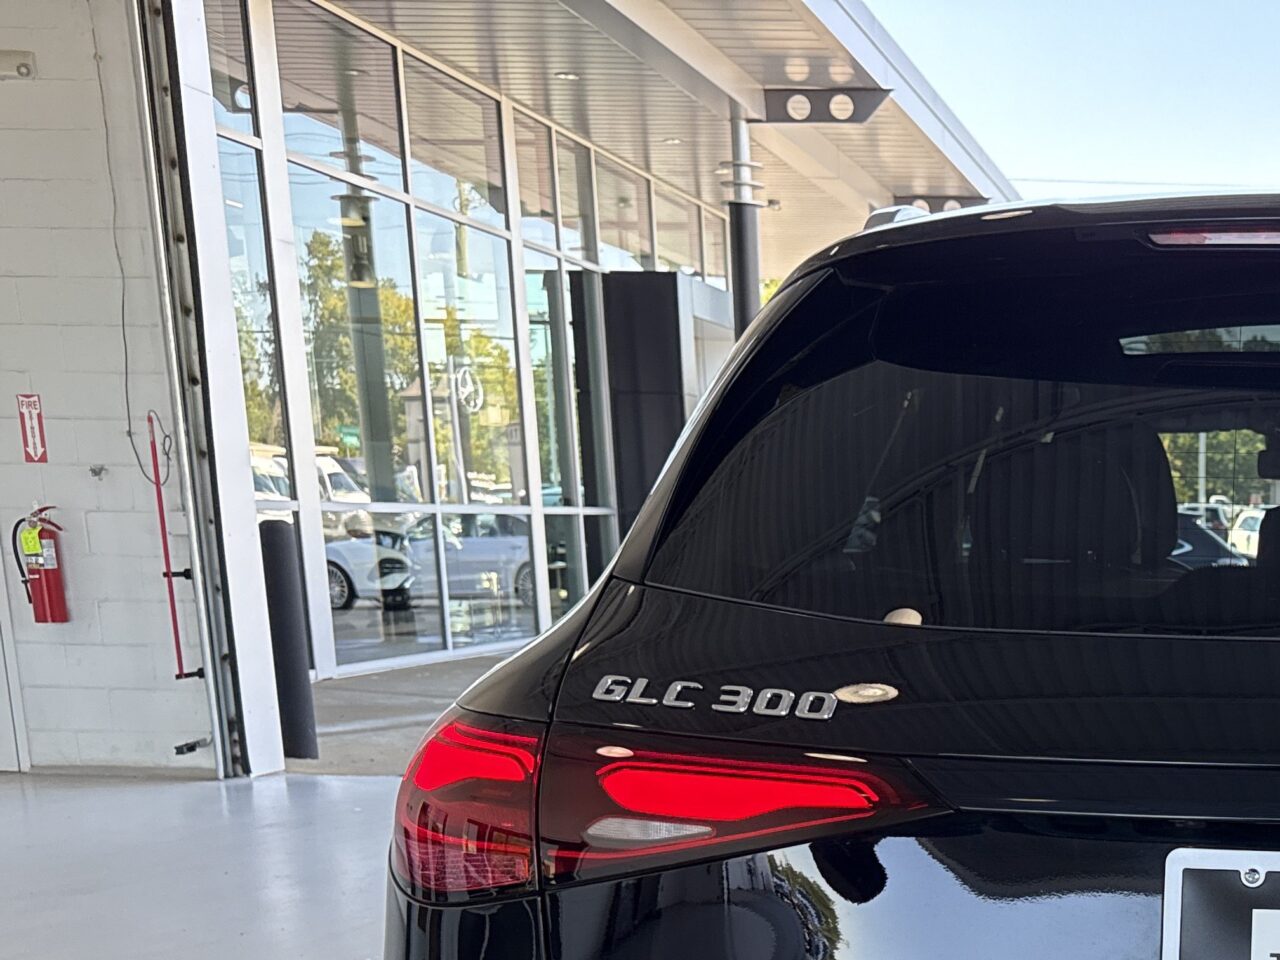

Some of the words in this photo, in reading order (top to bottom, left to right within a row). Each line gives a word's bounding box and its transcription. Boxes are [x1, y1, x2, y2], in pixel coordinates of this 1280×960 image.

[20, 400, 39, 411] FIRE
[592, 674, 704, 709] GLC
[711, 685, 838, 721] 300
